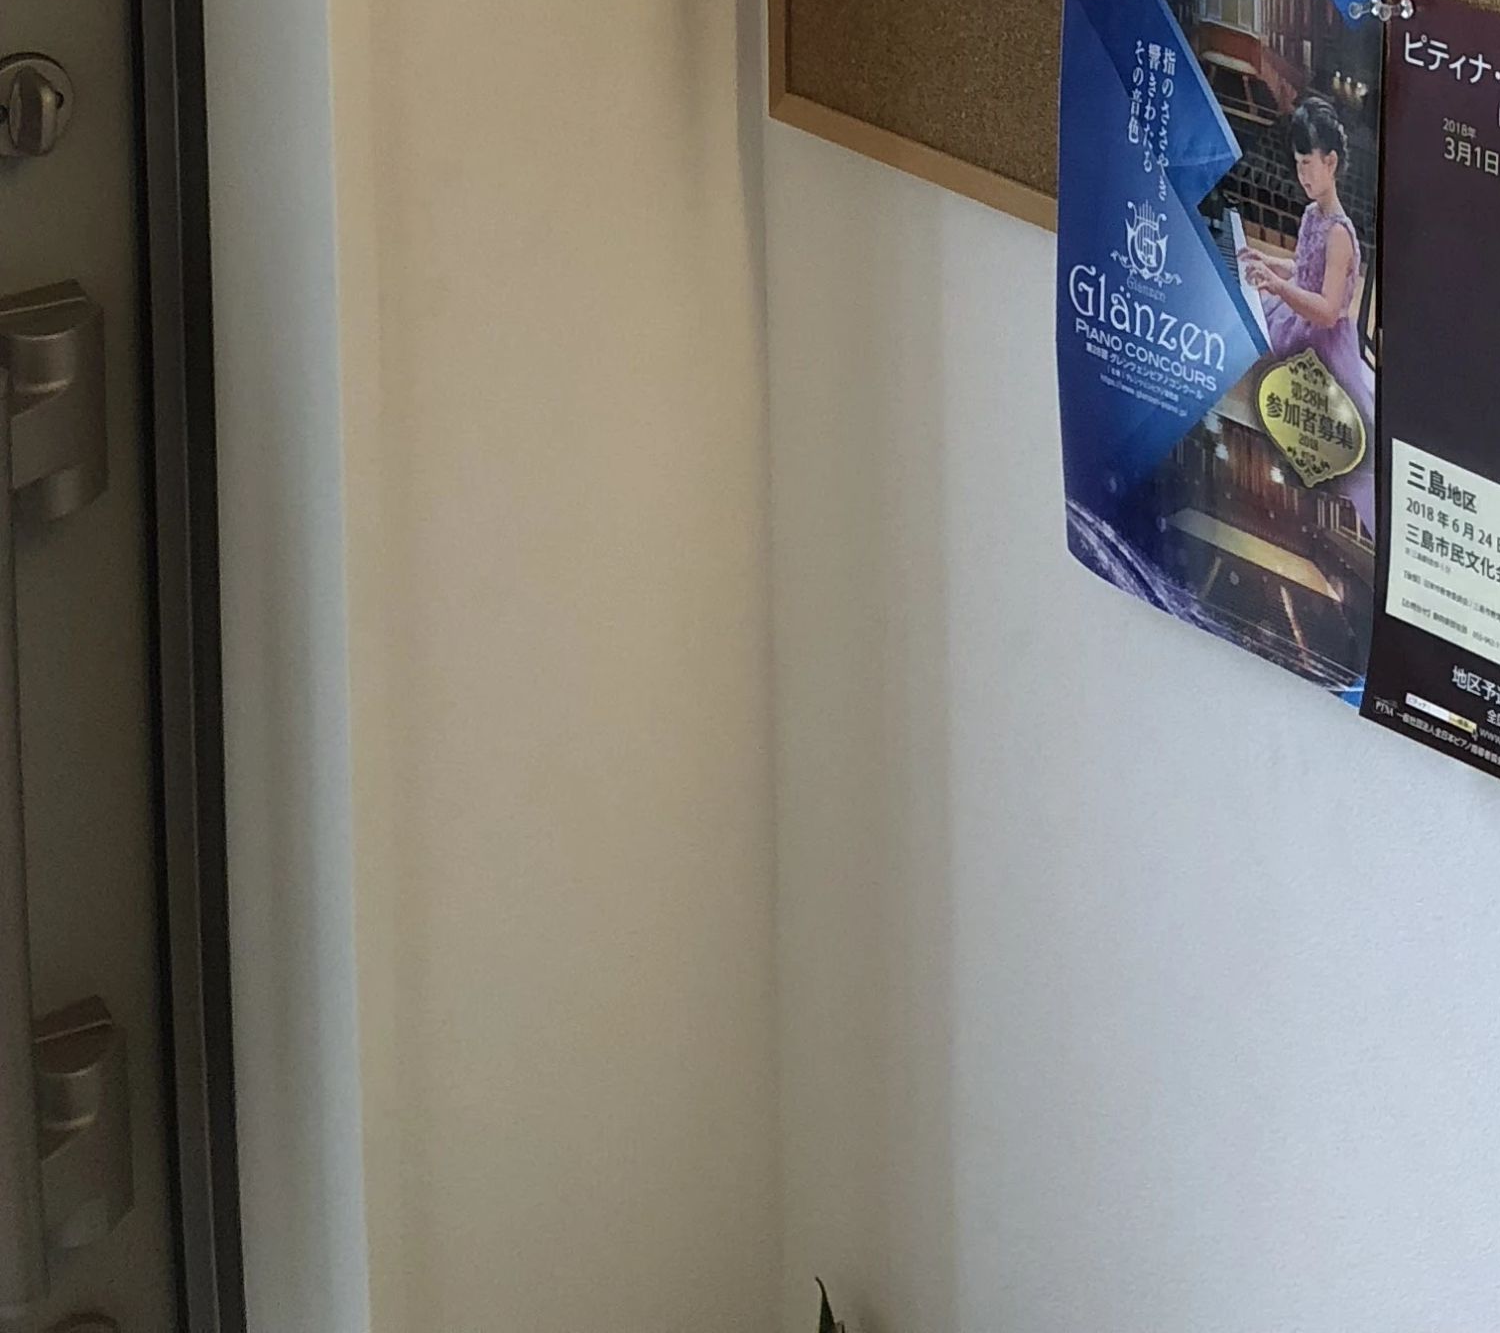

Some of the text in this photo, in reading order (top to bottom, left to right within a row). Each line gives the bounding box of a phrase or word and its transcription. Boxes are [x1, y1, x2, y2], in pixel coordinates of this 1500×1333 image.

[1442, 118, 1477, 139] 2018年
[1443, 136, 1499, 177] 3月1日
[1075, 319, 1123, 352] PIANO
[1125, 342, 1216, 391] CONCOURS
[1266, 392, 1353, 449] 参加者募集
[1407, 459, 1478, 515] 三島地区
